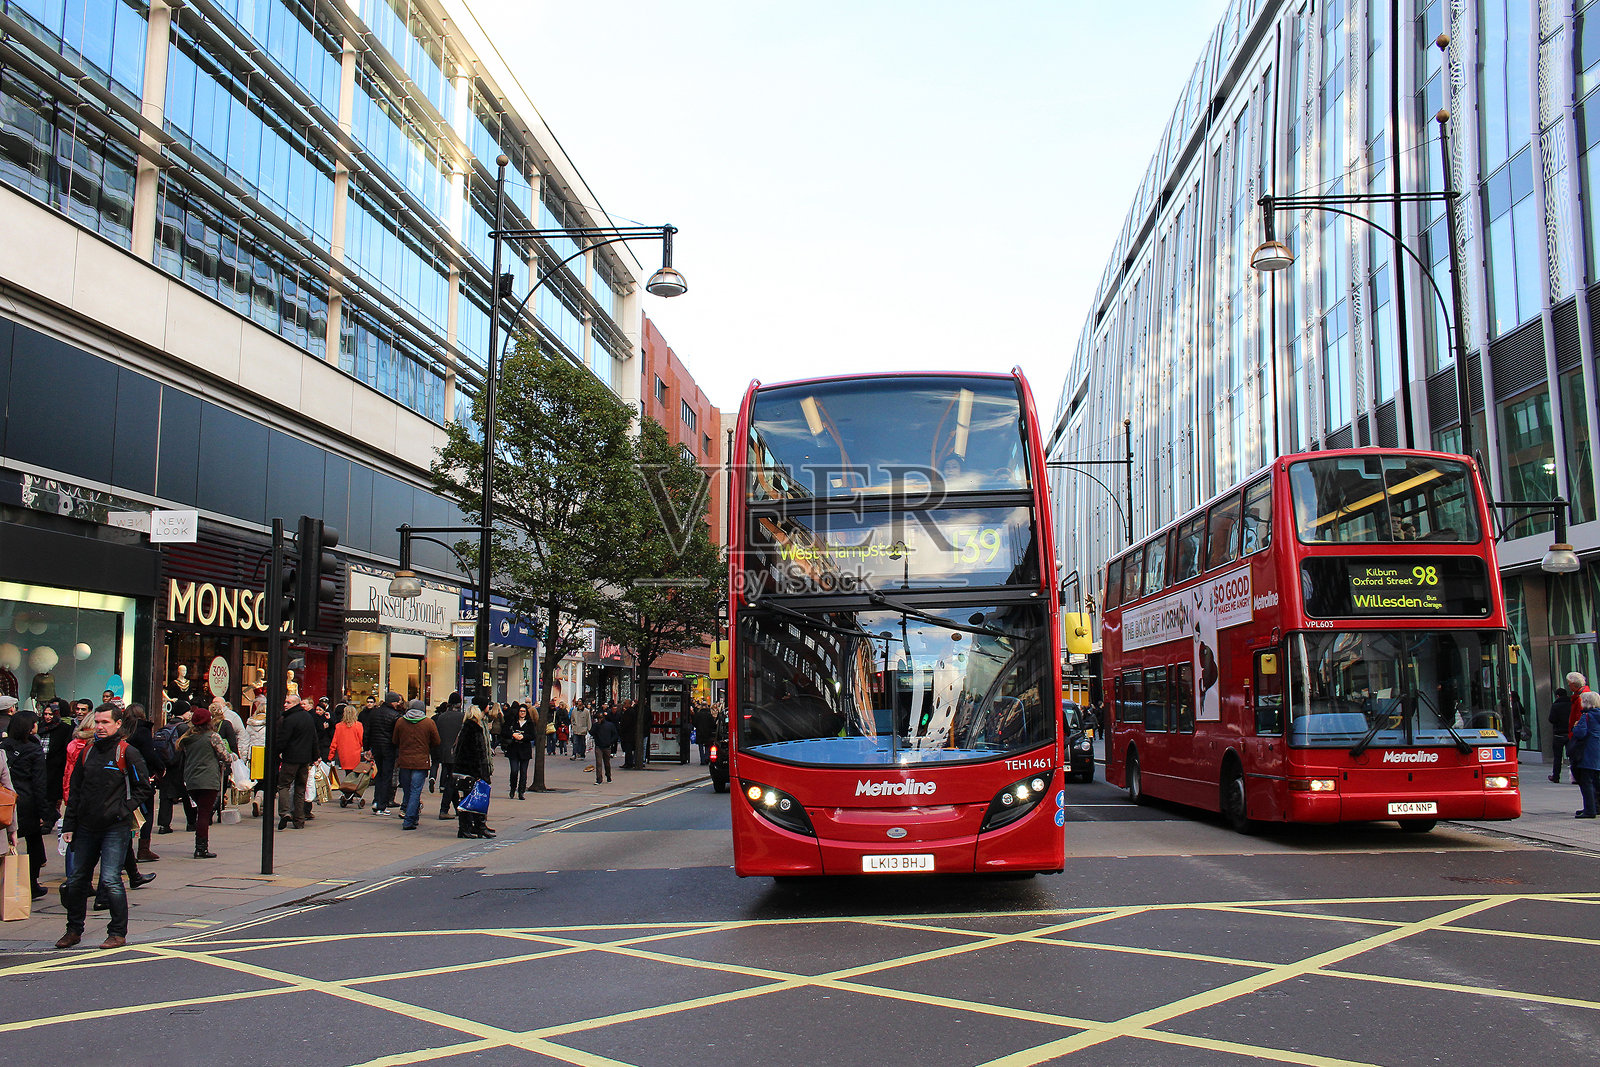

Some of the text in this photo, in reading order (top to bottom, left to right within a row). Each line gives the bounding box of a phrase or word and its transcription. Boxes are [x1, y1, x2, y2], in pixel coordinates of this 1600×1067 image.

[159, 517, 187, 526] NEW
[156, 527, 189, 536] LOOK
[779, 538, 912, 562] West Hampstead
[952, 528, 1001, 564] 139
[1365, 568, 1398, 577] Kilburn
[1411, 565, 1439, 586] 98
[1352, 576, 1414, 586] Oxford Street
[1213, 575, 1250, 605] SO GOOD
[1253, 590, 1279, 611] Metroline
[1352, 594, 1423, 608] Willesden
[1422, 601, 1443, 610] Garage
[1218, 602, 1231, 614] MAKES
[344, 616, 377, 624] MONSOON
[1305, 620, 1334, 628] VPL603
[1124, 623, 1135, 641] THE
[1135, 615, 1151, 639] BOOK
[1151, 613, 1160, 634] OF
[212, 665, 228, 678] 30%
[214, 677, 225, 685] OFF
[1382, 750, 1439, 763] Metroline
[1004, 757, 1052, 771] TEH1461
[855, 778, 937, 797] Metroline
[1390, 802, 1433, 813] LK04 NNP
[870, 856, 926, 869] LK13 BHJ
